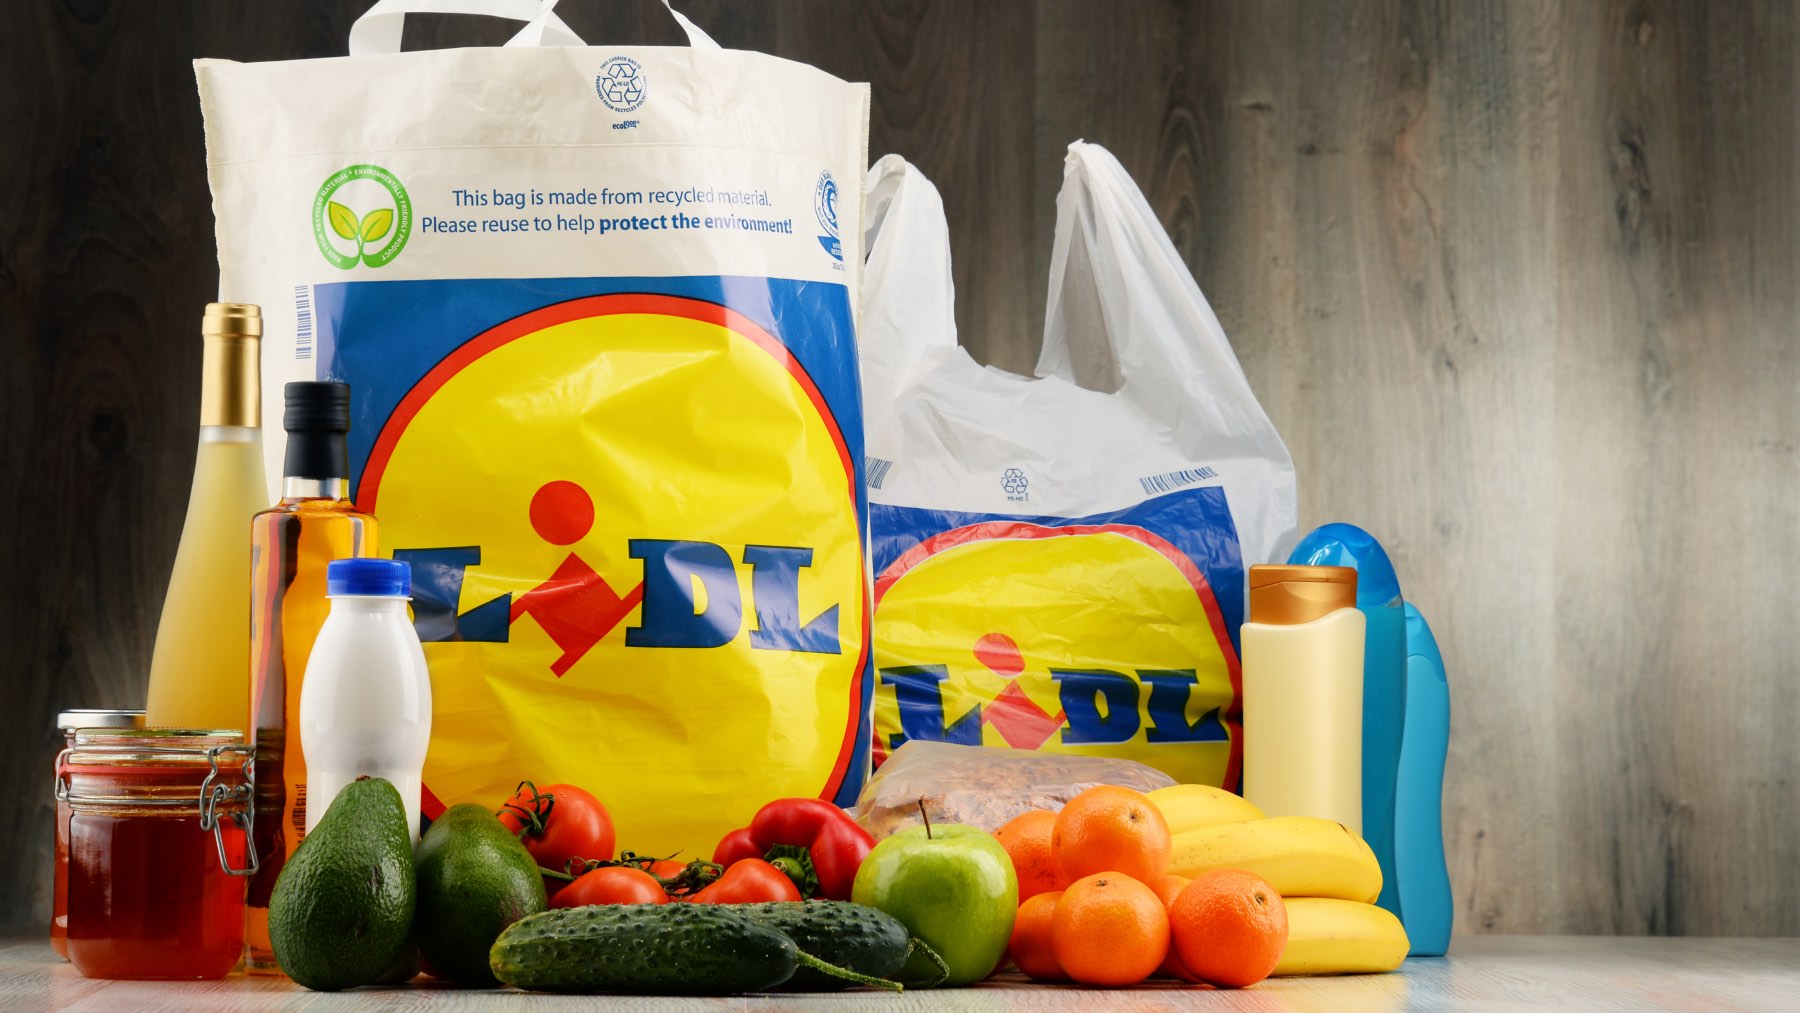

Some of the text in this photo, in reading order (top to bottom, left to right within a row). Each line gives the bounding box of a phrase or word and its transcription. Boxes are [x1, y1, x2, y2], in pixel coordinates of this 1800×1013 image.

[600, 61, 609, 70] THIS
[596, 76, 604, 100] PRODUCED
[603, 100, 614, 110] FROM
[321, 173, 348, 196] MATERIAL
[354, 168, 404, 199] ENVIRONMENTALLY
[452, 186, 772, 210] This bag is made from recycled material.
[400, 200, 408, 234] FRIENDLY
[422, 212, 793, 234] Please reuse to help protect the environment!
[382, 234, 404, 260] PRODUCT
